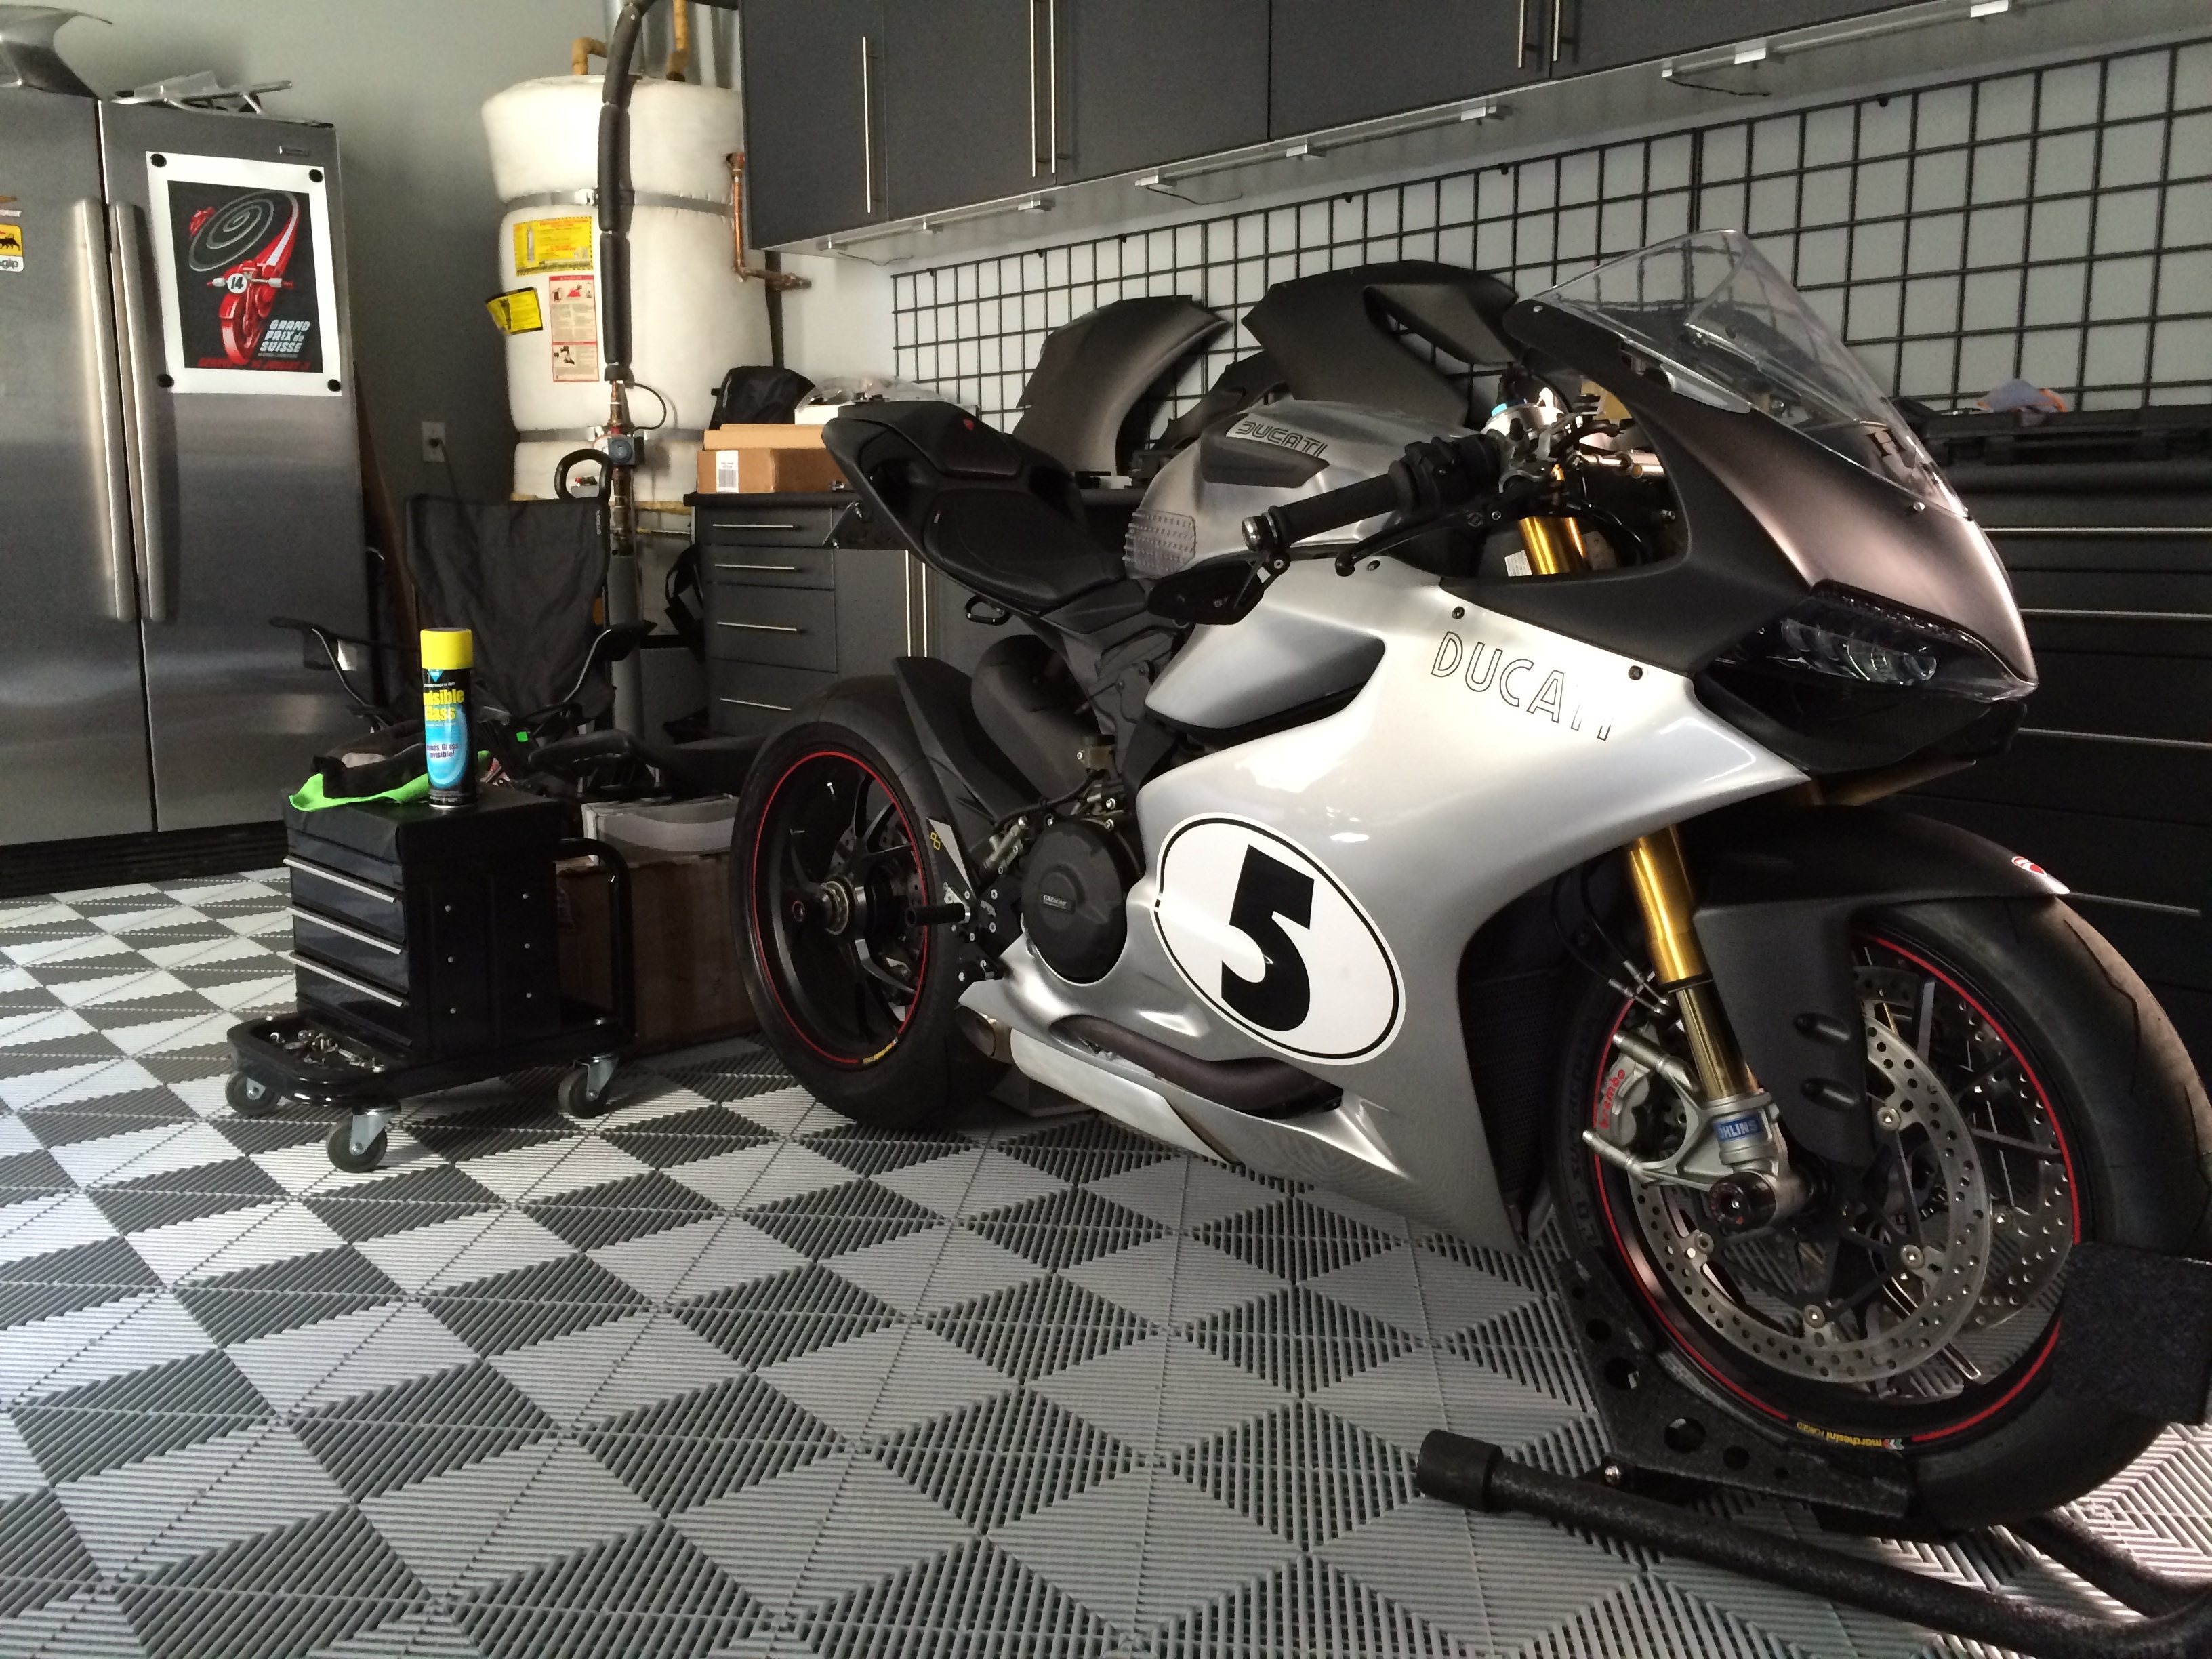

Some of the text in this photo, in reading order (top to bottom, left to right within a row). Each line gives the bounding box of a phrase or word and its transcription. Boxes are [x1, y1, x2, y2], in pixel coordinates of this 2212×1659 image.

[231, 276, 244, 289] 14
[269, 319, 310, 331] GRAND
[264, 330, 304, 342] PRIX de
[260, 341, 302, 353] SUISSE
[1235, 420, 1328, 458] DUCATI
[1221, 844, 1315, 1031] 5
[1599, 1069, 1625, 1129] brembo
[1826, 1431, 1883, 1447] marchesini
